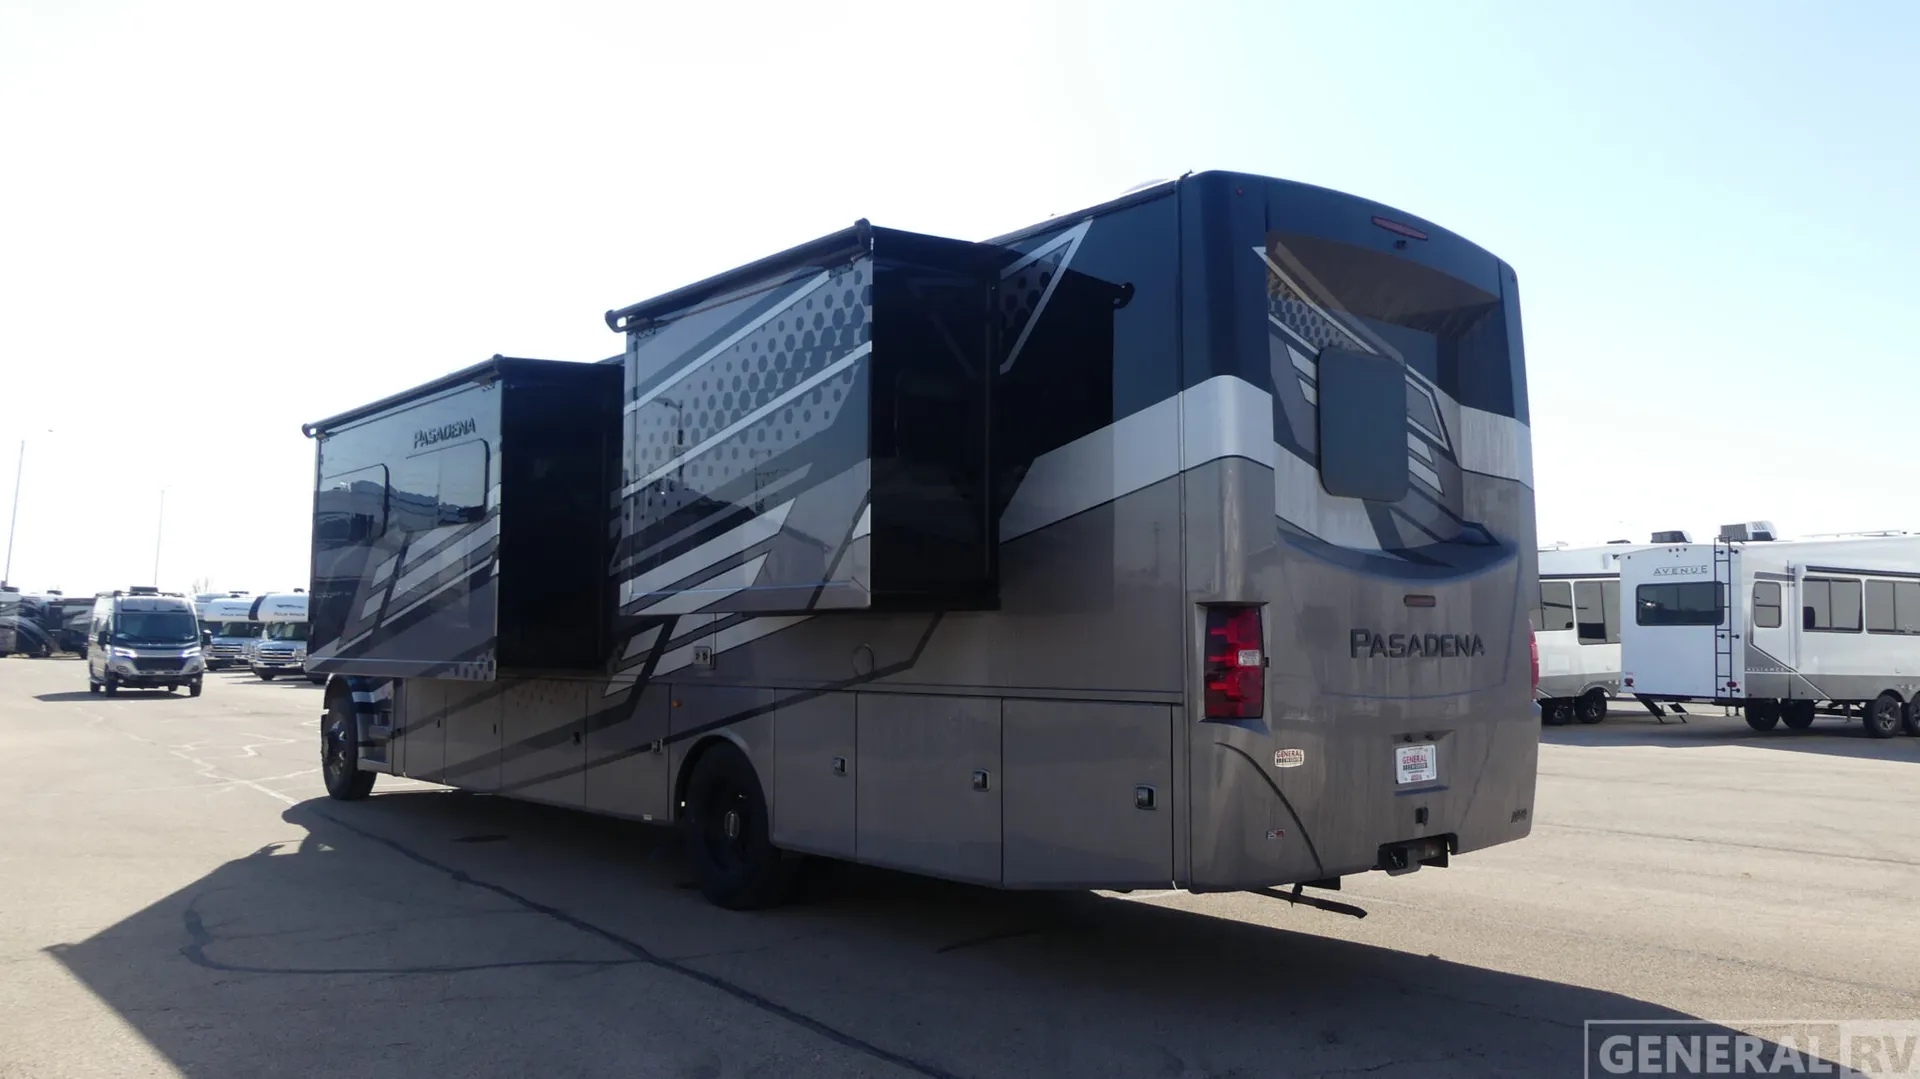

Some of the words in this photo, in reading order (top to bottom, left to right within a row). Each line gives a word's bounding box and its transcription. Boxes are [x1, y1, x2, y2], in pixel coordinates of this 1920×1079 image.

[413, 417, 477, 449] PASADENA
[1653, 564, 1708, 576] AVENUE
[1350, 628, 1486, 658] PASADENA
[1402, 754, 1428, 765] GENERAL
